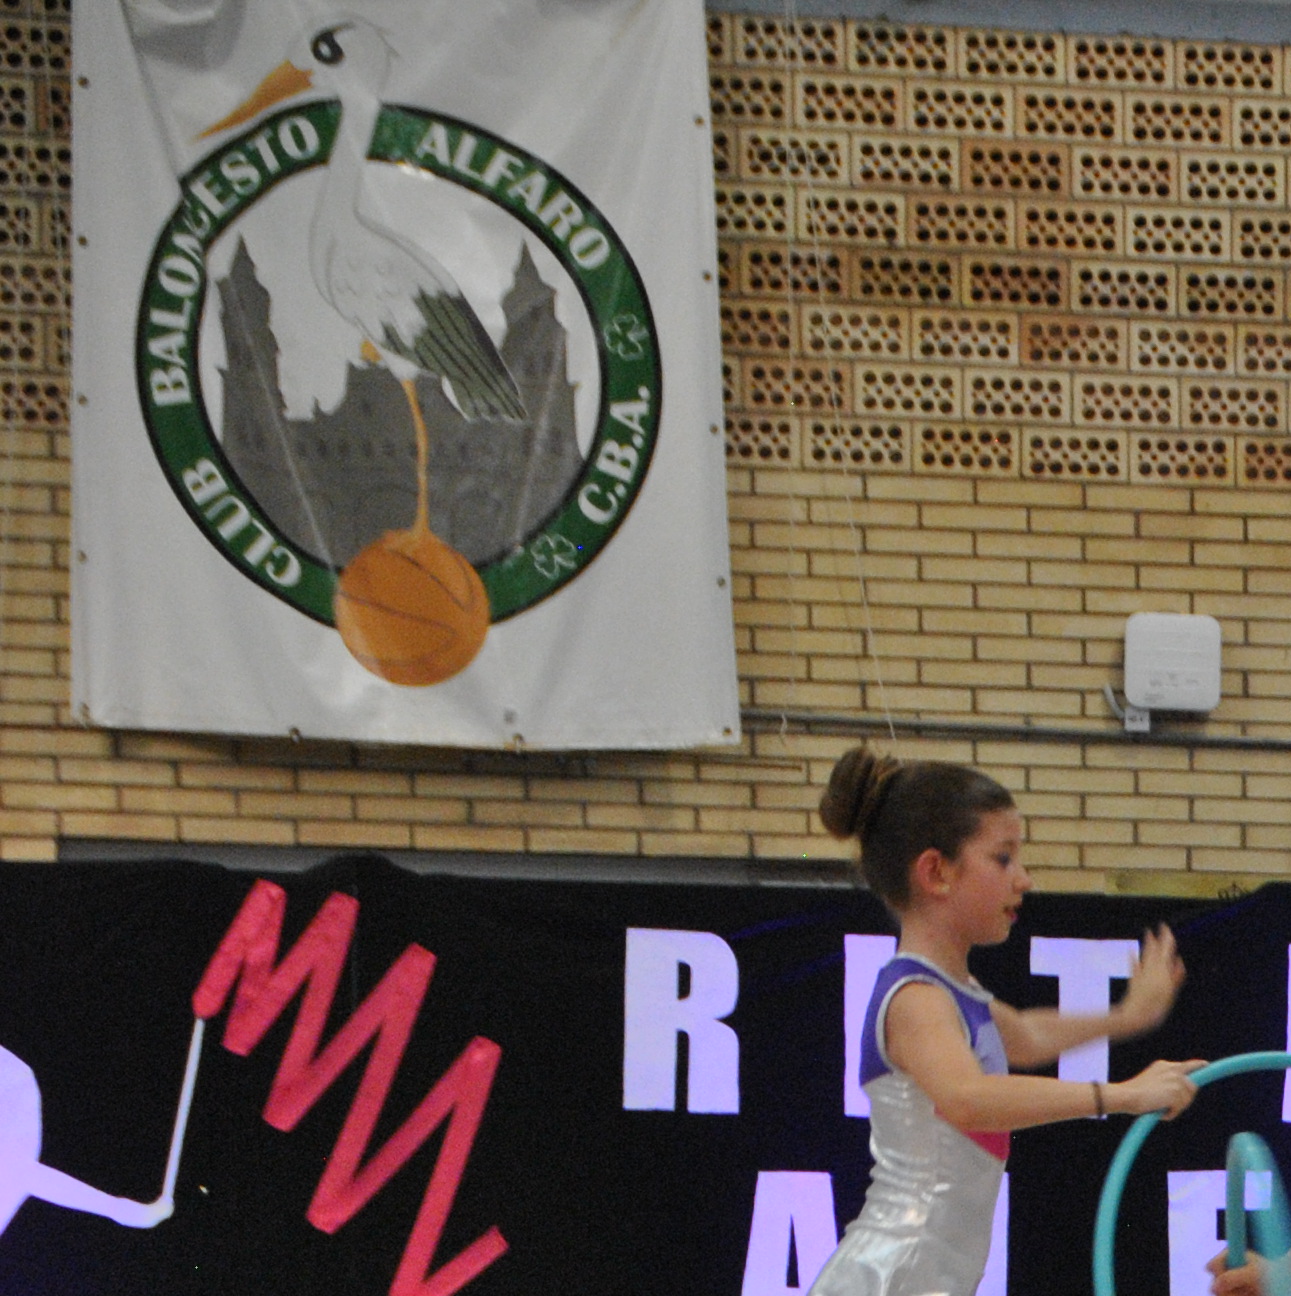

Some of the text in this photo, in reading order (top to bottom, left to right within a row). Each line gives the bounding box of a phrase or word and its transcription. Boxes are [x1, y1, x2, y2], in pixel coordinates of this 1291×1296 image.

[181, 456, 301, 588] CLUB
[414, 120, 611, 271] ALFARO
[576, 384, 650, 525] C.B.A.
